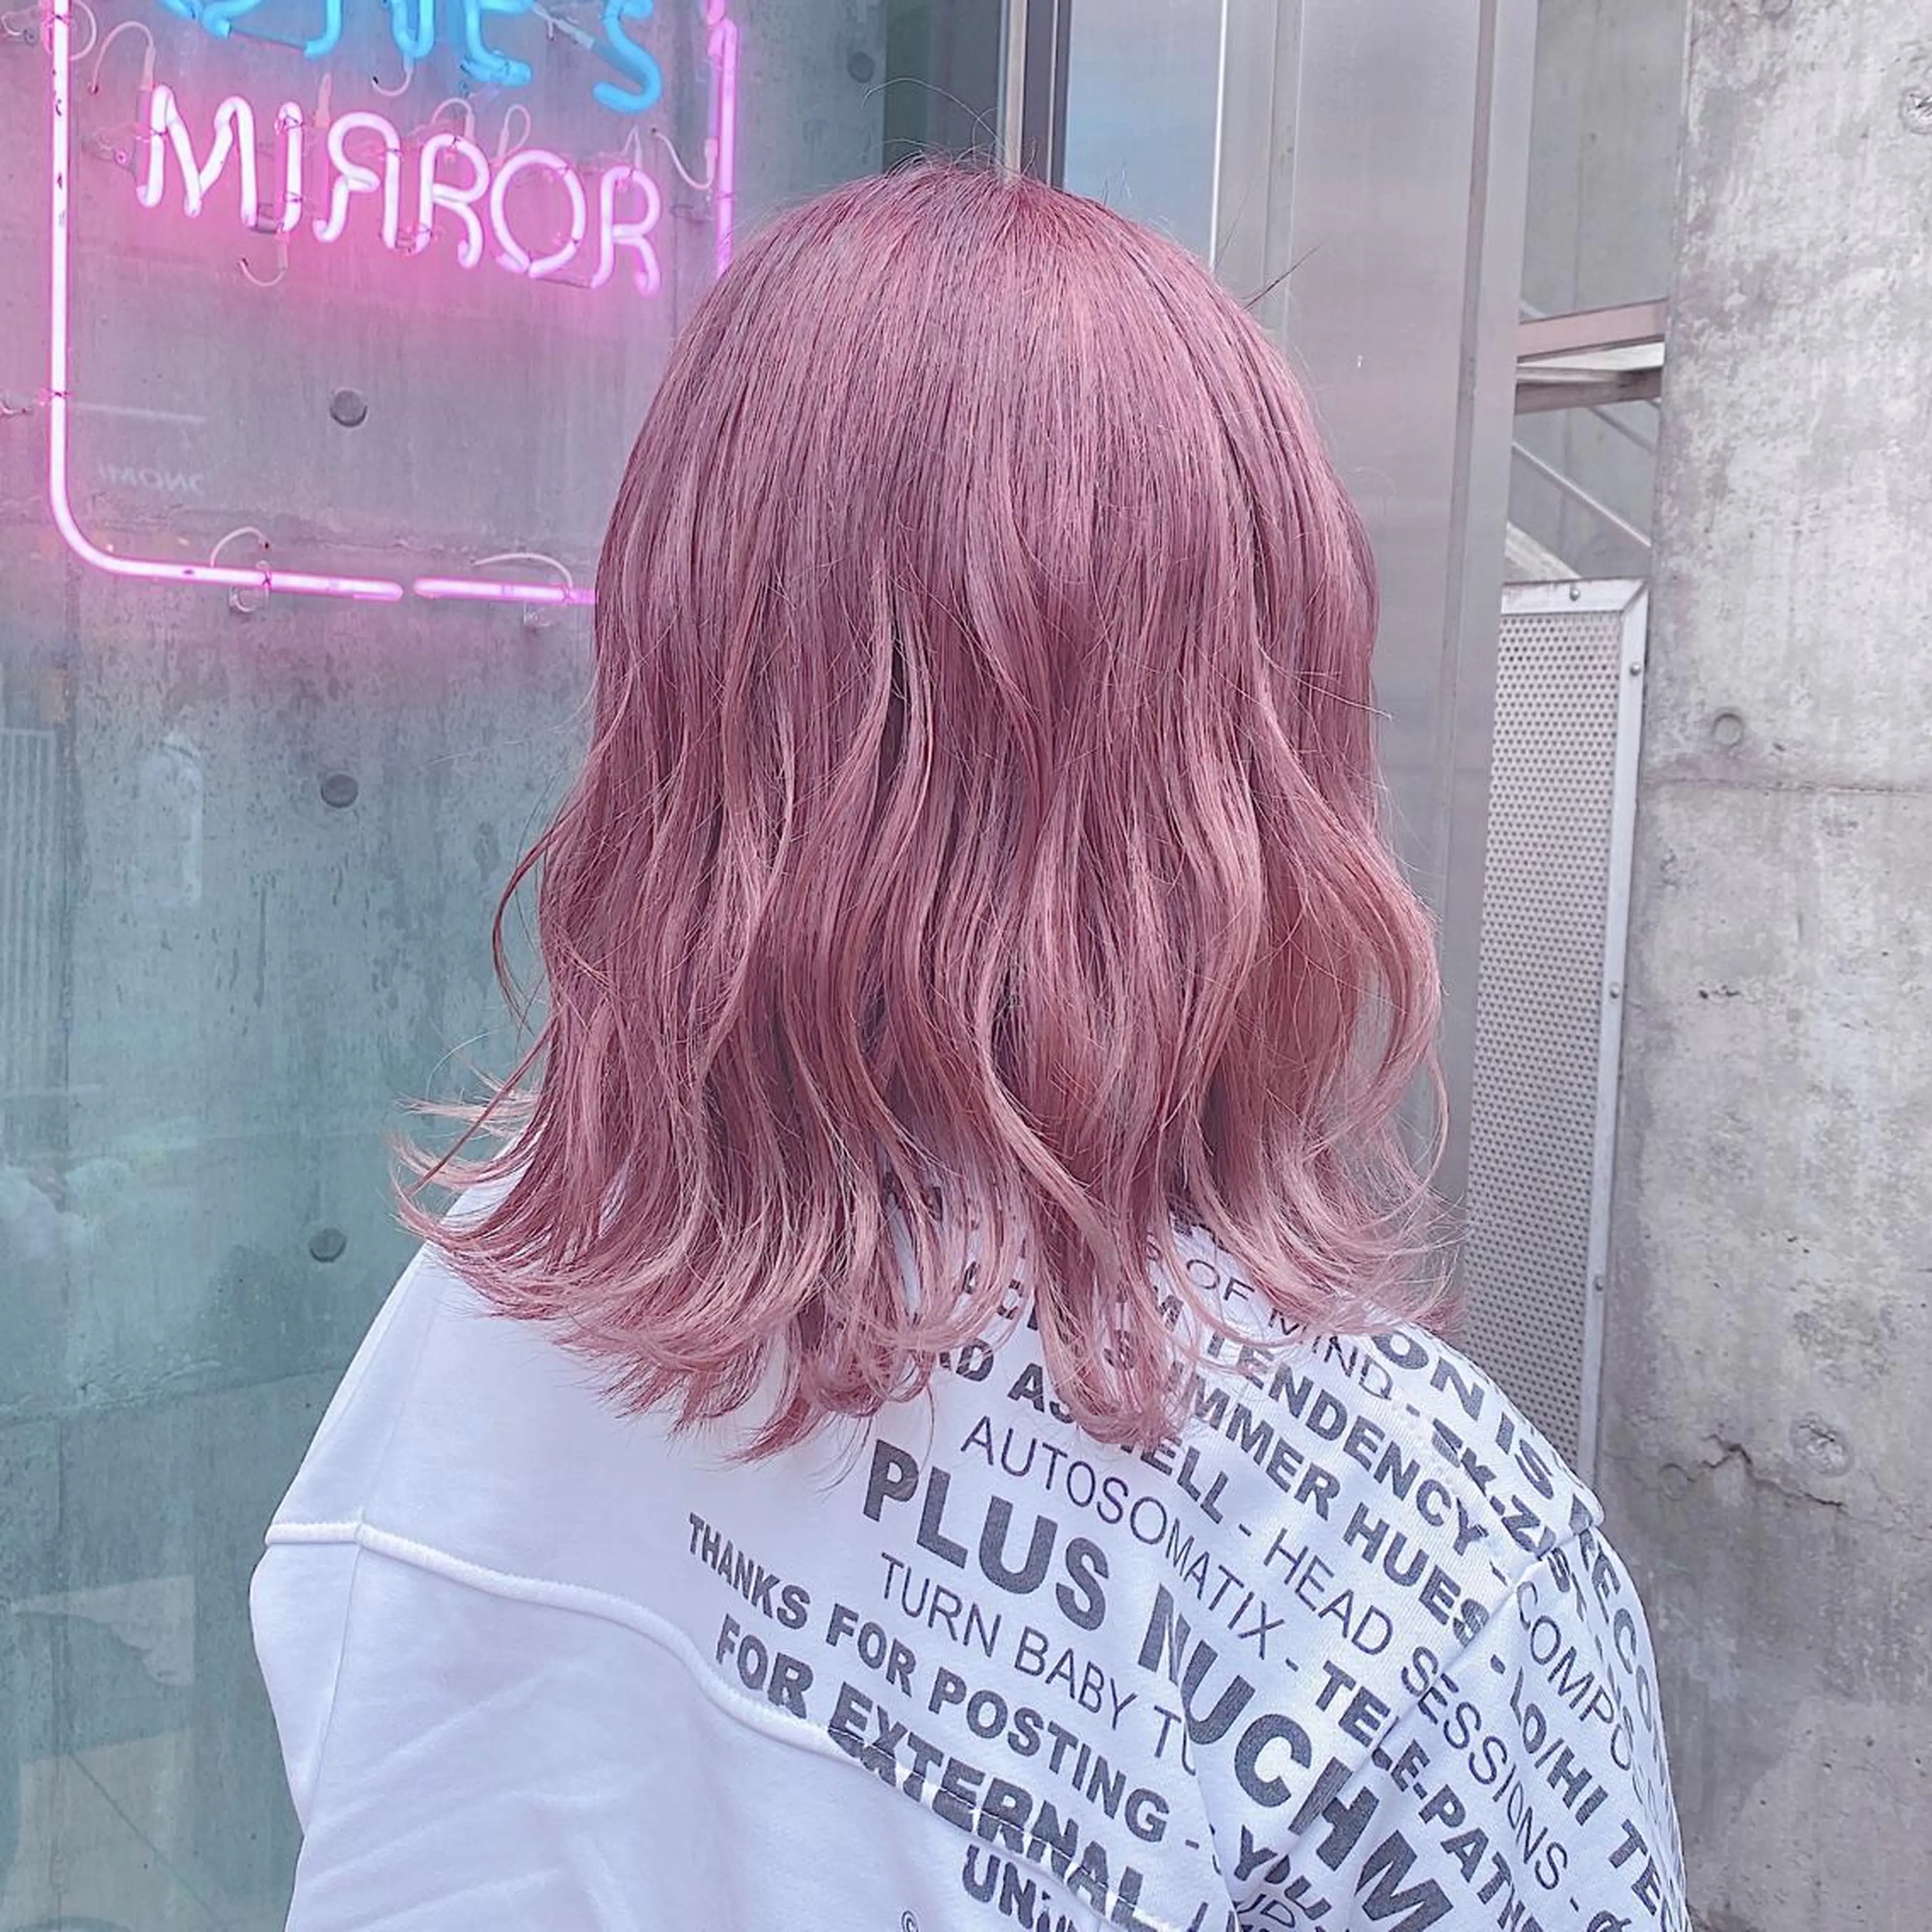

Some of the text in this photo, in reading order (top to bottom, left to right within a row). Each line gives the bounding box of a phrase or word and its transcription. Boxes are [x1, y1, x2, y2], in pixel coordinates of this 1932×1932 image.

[135, 82, 662, 297] MIRROR
[1186, 1259, 1255, 1302] OF
[862, 1438, 1109, 1632] PLUS
[880, 1552, 1002, 1658] TURN
[1014, 1626, 1138, 1731] BABY
[960, 1415, 1287, 1660] AUTOSOMATIX
[1342, 1499, 1490, 1648] HUES
[687, 1512, 811, 1631] THANKS
[825, 1601, 918, 1699] FOR
[927, 1667, 1170, 1843] POSTING
[716, 1613, 1159, 1932] FOR EXTERNAL
[1263, 1528, 1393, 1655] HEAD
[1401, 1646, 1568, 1890] SESSIONS
